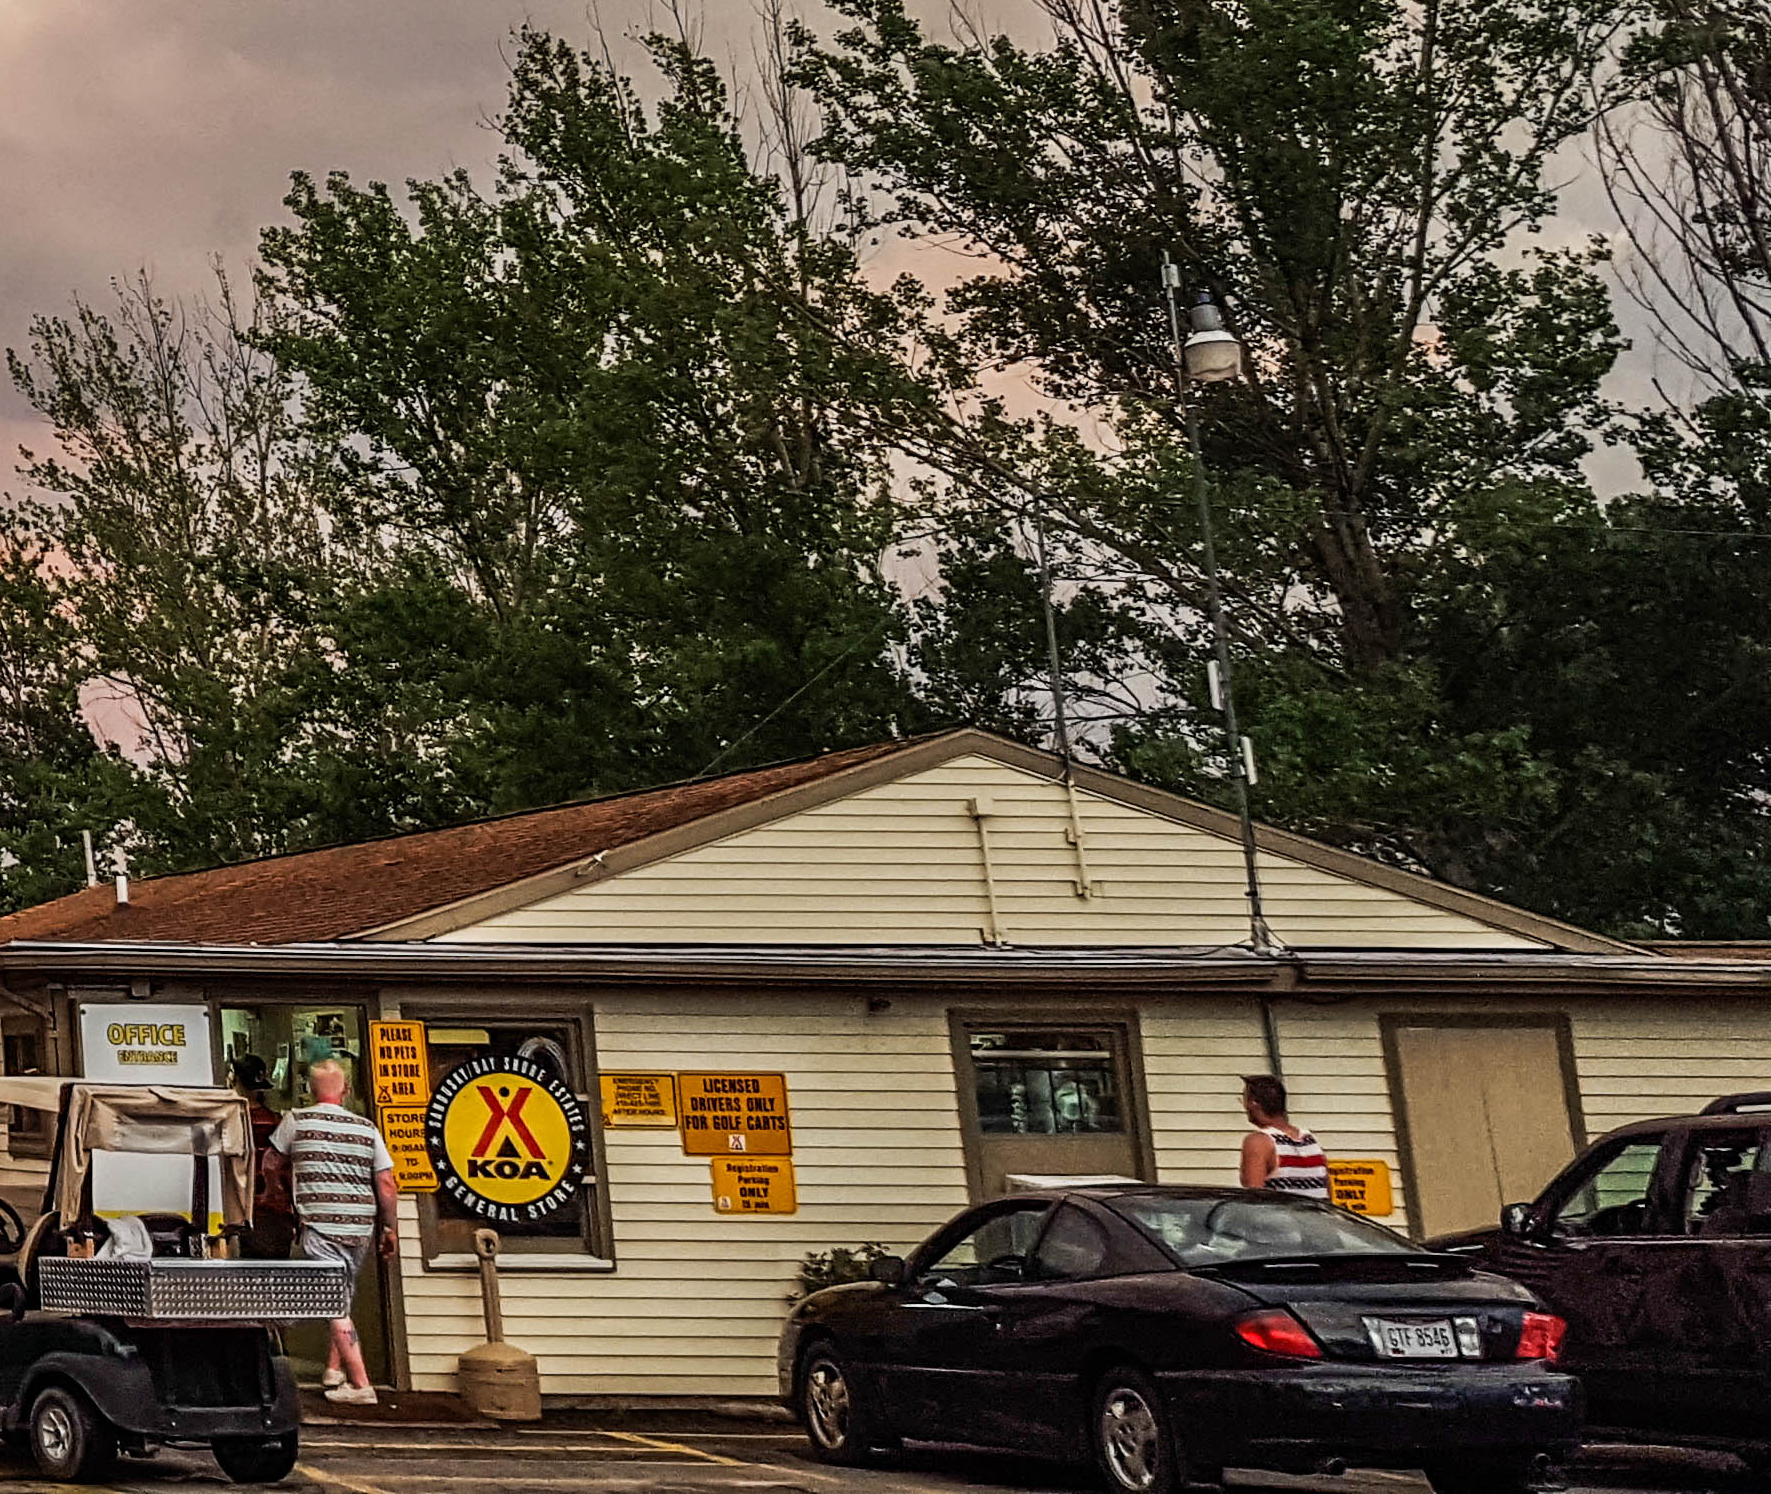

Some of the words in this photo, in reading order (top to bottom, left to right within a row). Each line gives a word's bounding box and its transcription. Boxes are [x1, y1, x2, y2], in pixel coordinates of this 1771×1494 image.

[107, 1022, 186, 1046] OFFICE
[380, 1028, 412, 1041] PLEASE
[118, 1050, 179, 1065] ENTRANCE
[379, 1046, 392, 1059] NO
[394, 1046, 417, 1059] PETS
[379, 1064, 389, 1077] IN
[391, 1064, 420, 1077] STORE
[392, 1082, 416, 1095] AREA
[703, 1078, 760, 1093] LICENSED
[504, 1057, 546, 1082] SHORE
[549, 1080, 585, 1132] ESTATES
[691, 1097, 741, 1112] DRIVERS
[747, 1097, 775, 1112] ONLY
[387, 1114, 426, 1123] STORE
[685, 1115, 708, 1130] FOR
[713, 1115, 741, 1130] GOLF
[747, 1115, 785, 1130] CARTS
[467, 1159, 551, 1180] KOA
[726, 1163, 778, 1173] Registration
[738, 1175, 769, 1185] Parking
[739, 1187, 768, 1197] ONLY
[1335, 1190, 1365, 1199] ONLY
[445, 1176, 519, 1222] GENERAL
[528, 1179, 575, 1219] STORE
